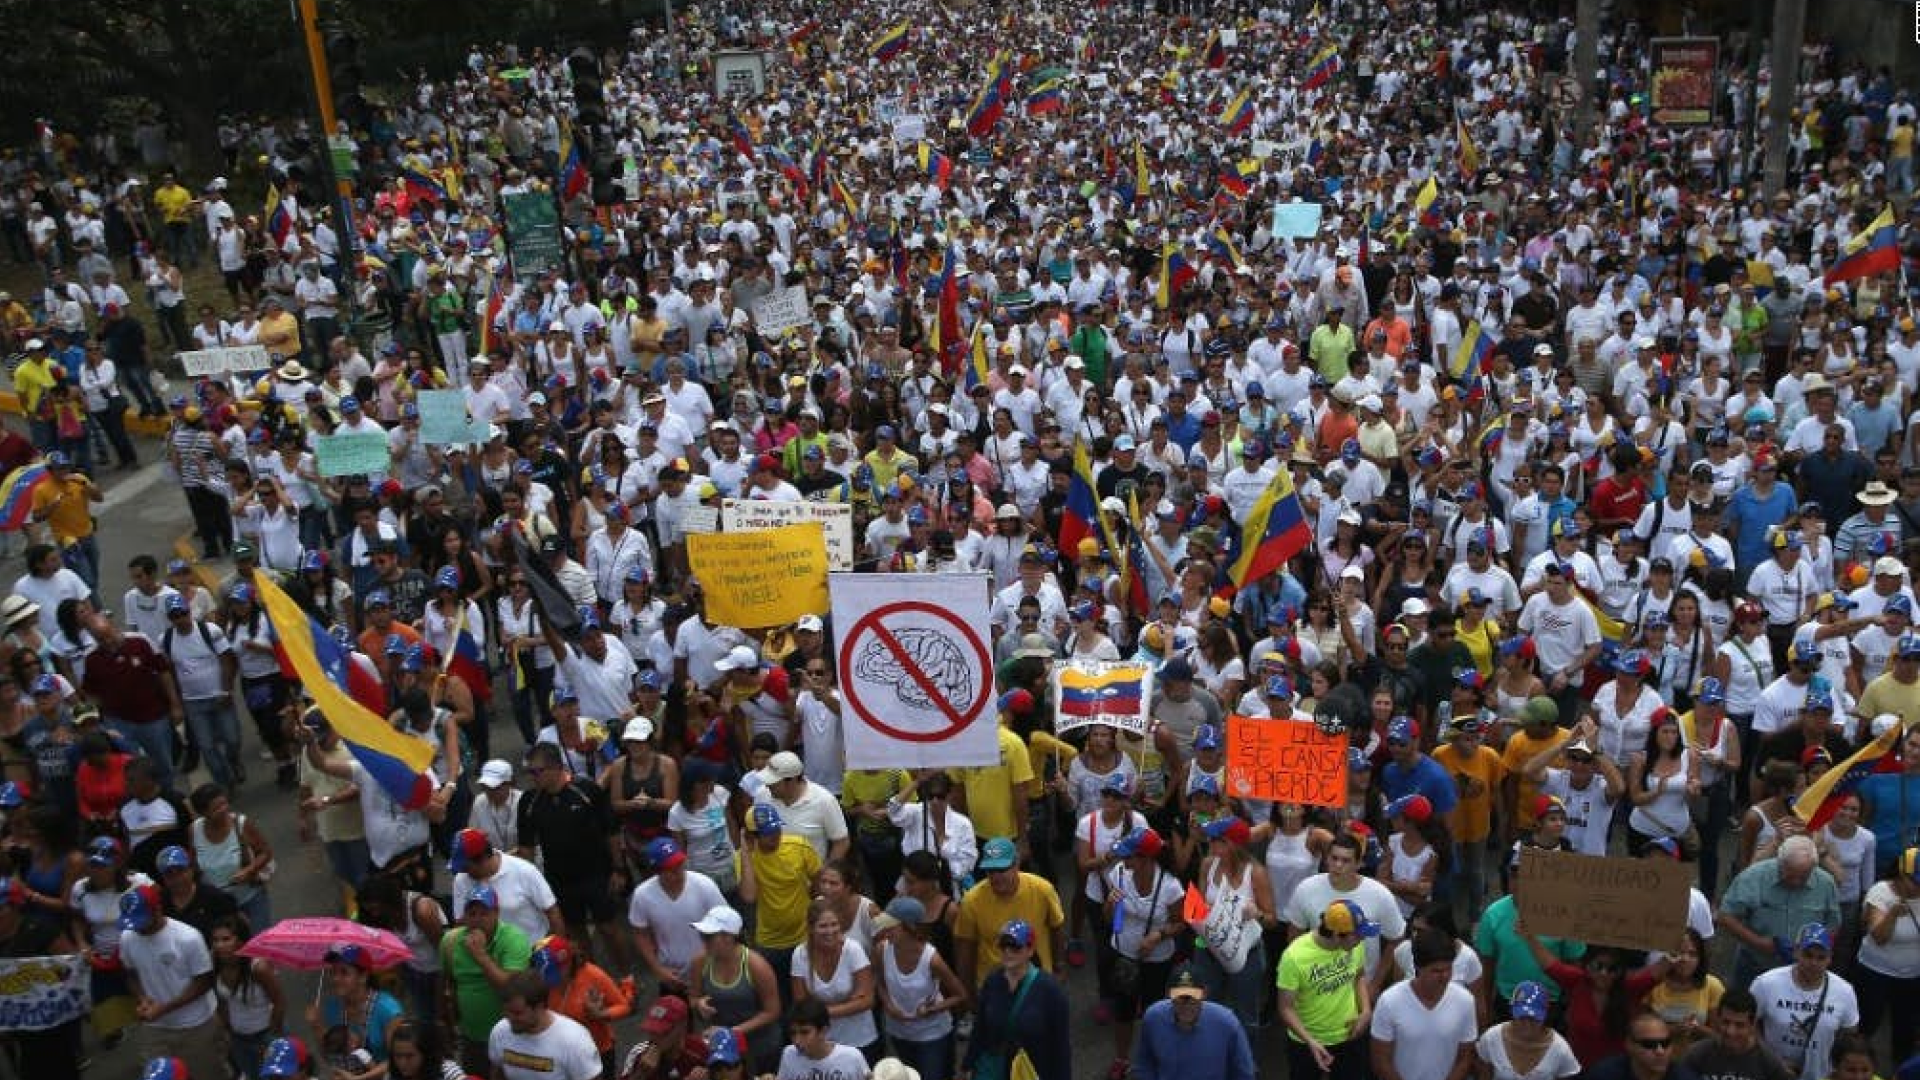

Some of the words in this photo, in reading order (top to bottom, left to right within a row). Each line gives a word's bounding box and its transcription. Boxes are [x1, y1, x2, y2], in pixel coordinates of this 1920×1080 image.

[1239, 723, 1273, 744] EL
[1280, 746, 1348, 772] CANSA
[1254, 768, 1338, 803] PIERDE
[1776, 998, 1835, 1014] AMERICN
